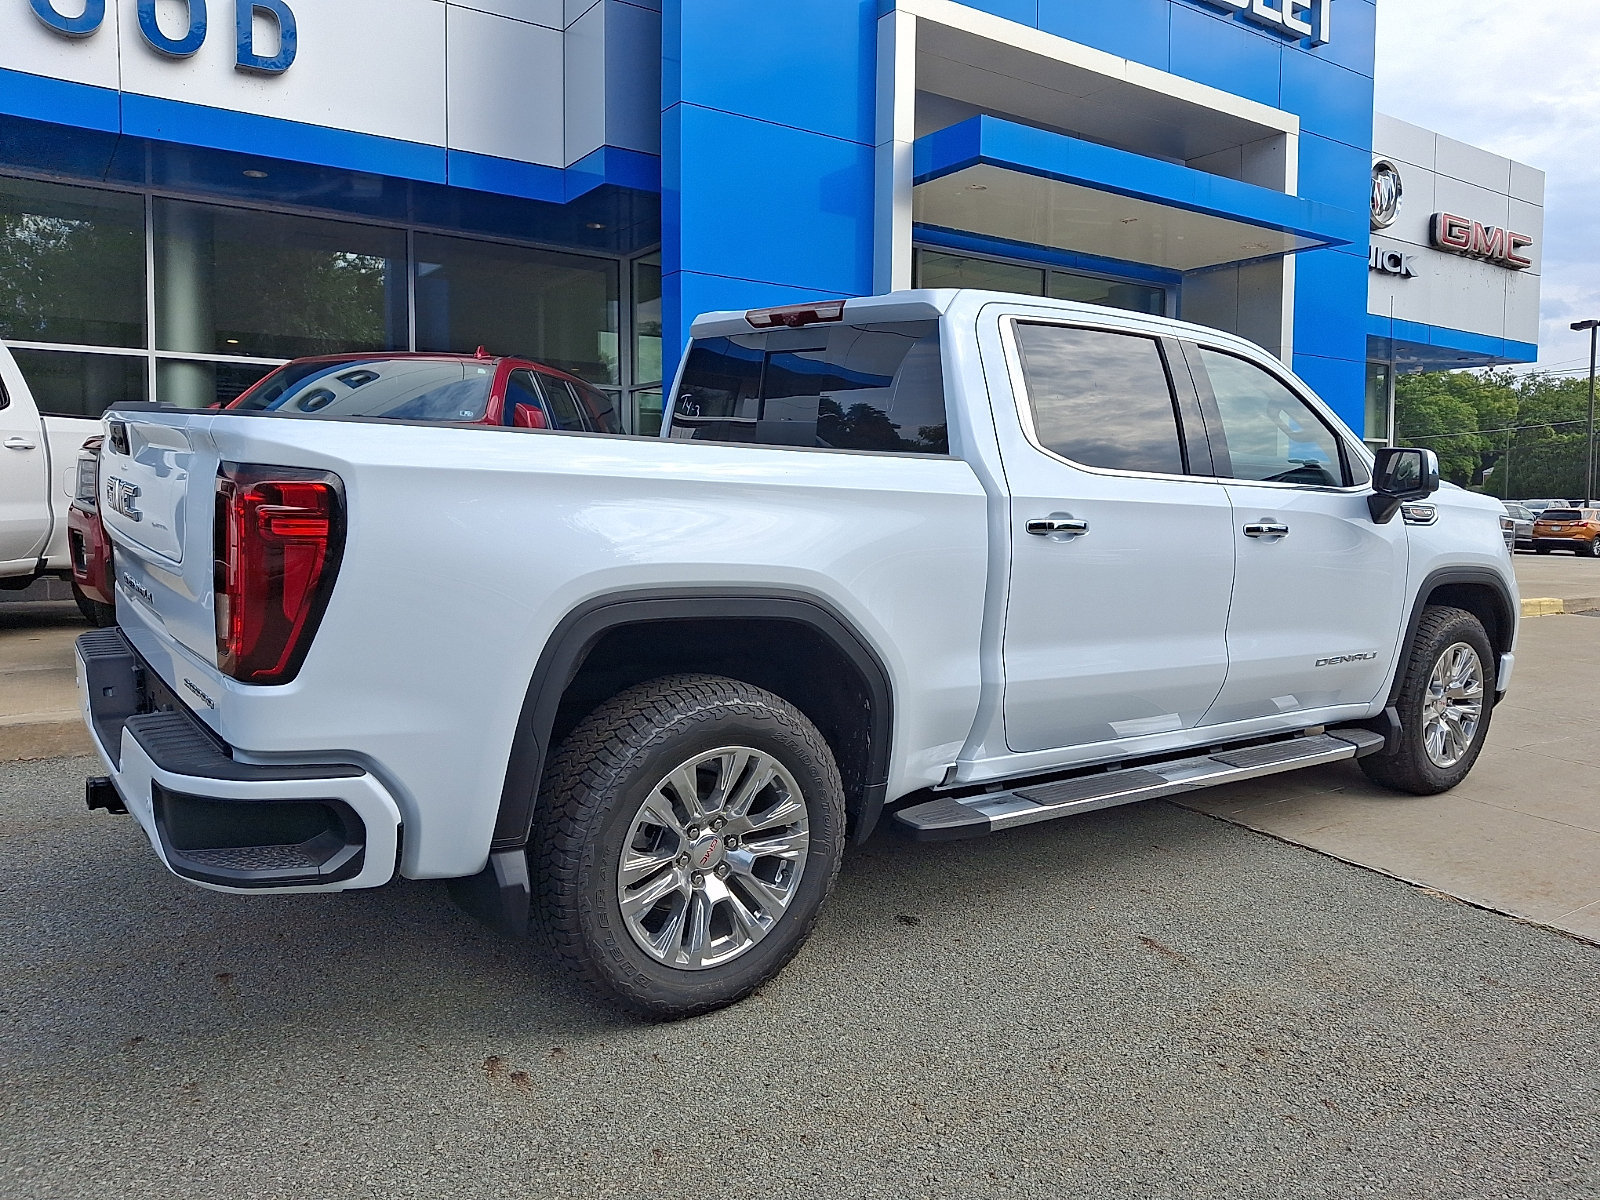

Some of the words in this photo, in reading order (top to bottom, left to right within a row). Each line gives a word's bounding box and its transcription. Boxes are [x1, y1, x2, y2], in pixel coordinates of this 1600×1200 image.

[1430, 211, 1534, 271] GMC
[1315, 651, 1378, 667] DENALI
[699, 837, 719, 866] GMC
[595, 889, 653, 988] DUELER
